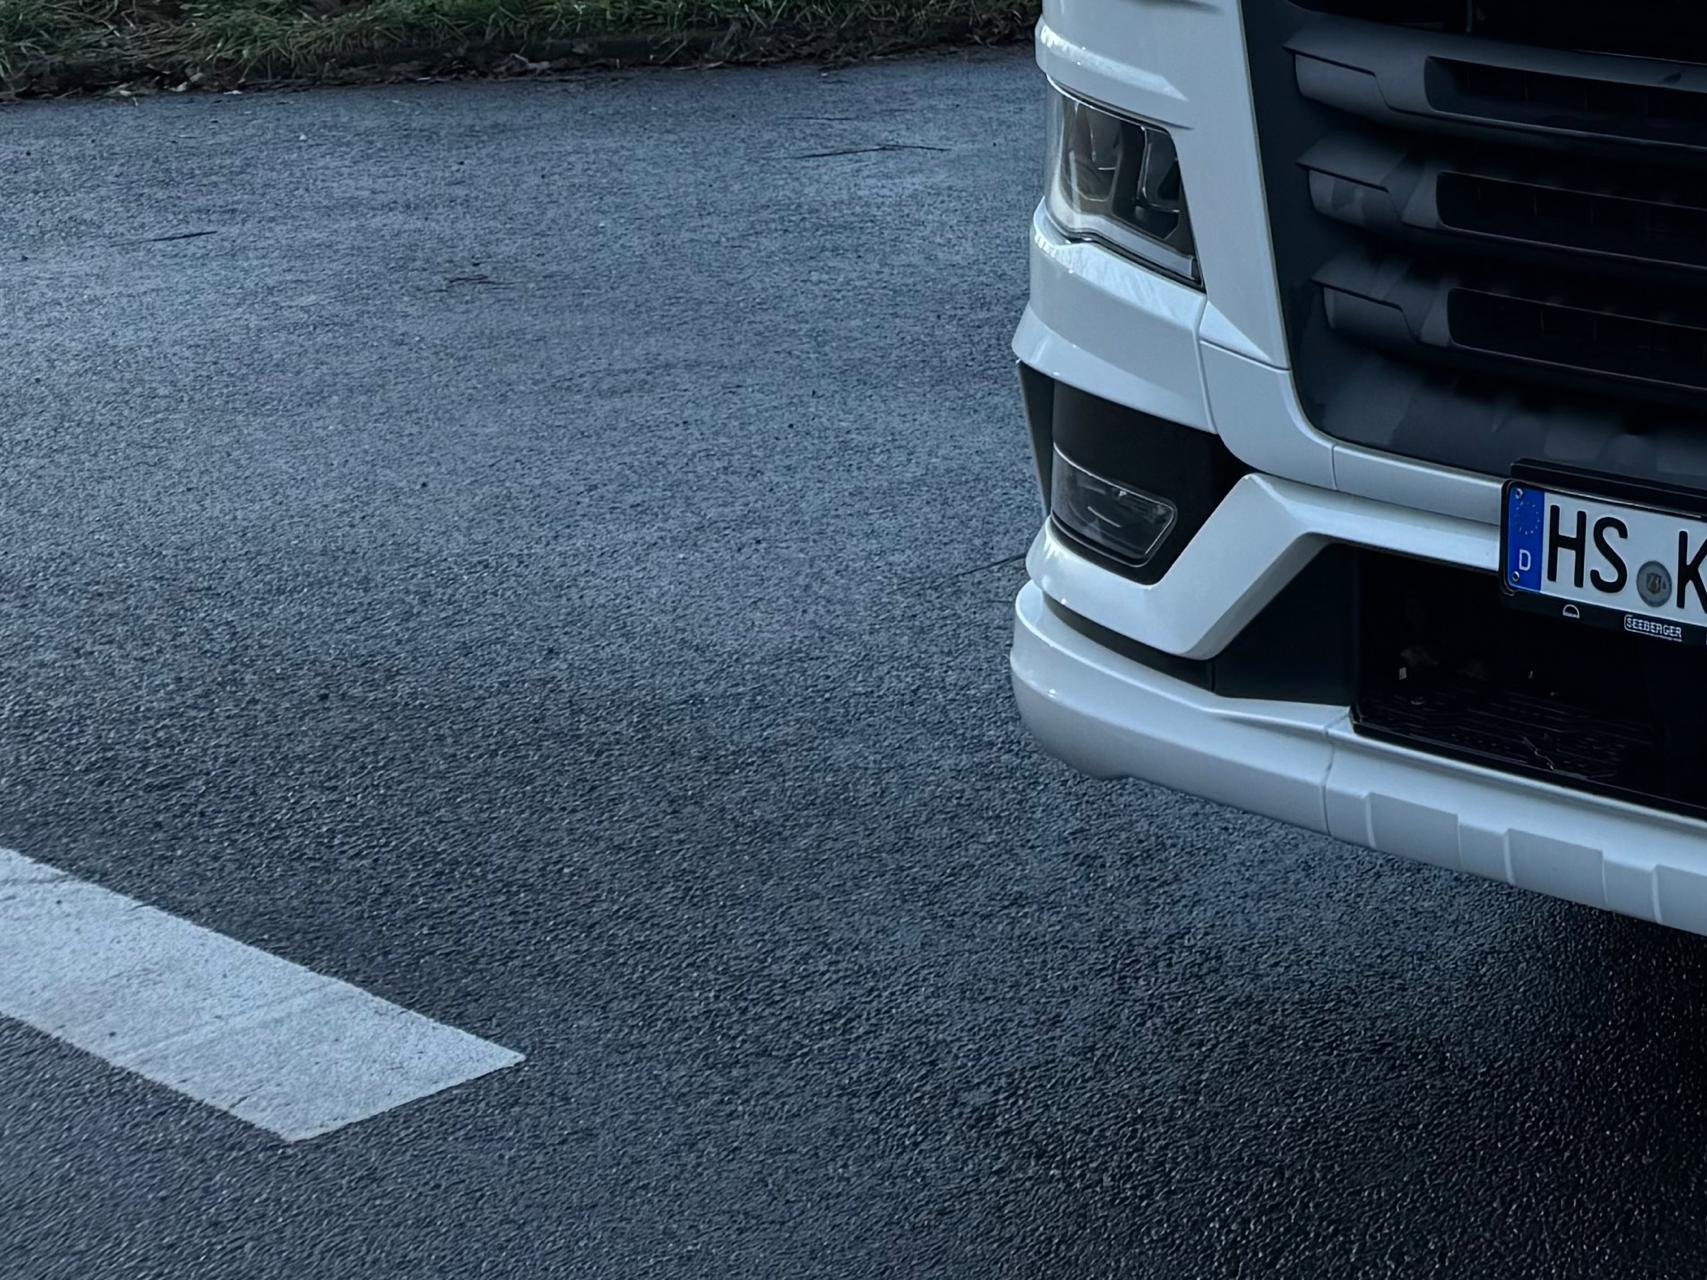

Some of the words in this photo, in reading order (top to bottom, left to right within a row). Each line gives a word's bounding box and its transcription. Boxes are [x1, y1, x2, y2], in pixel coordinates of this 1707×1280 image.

[1519, 549, 1532, 571] D
[1546, 504, 1628, 594] HS
[1625, 617, 1683, 638] SEEBERGER
